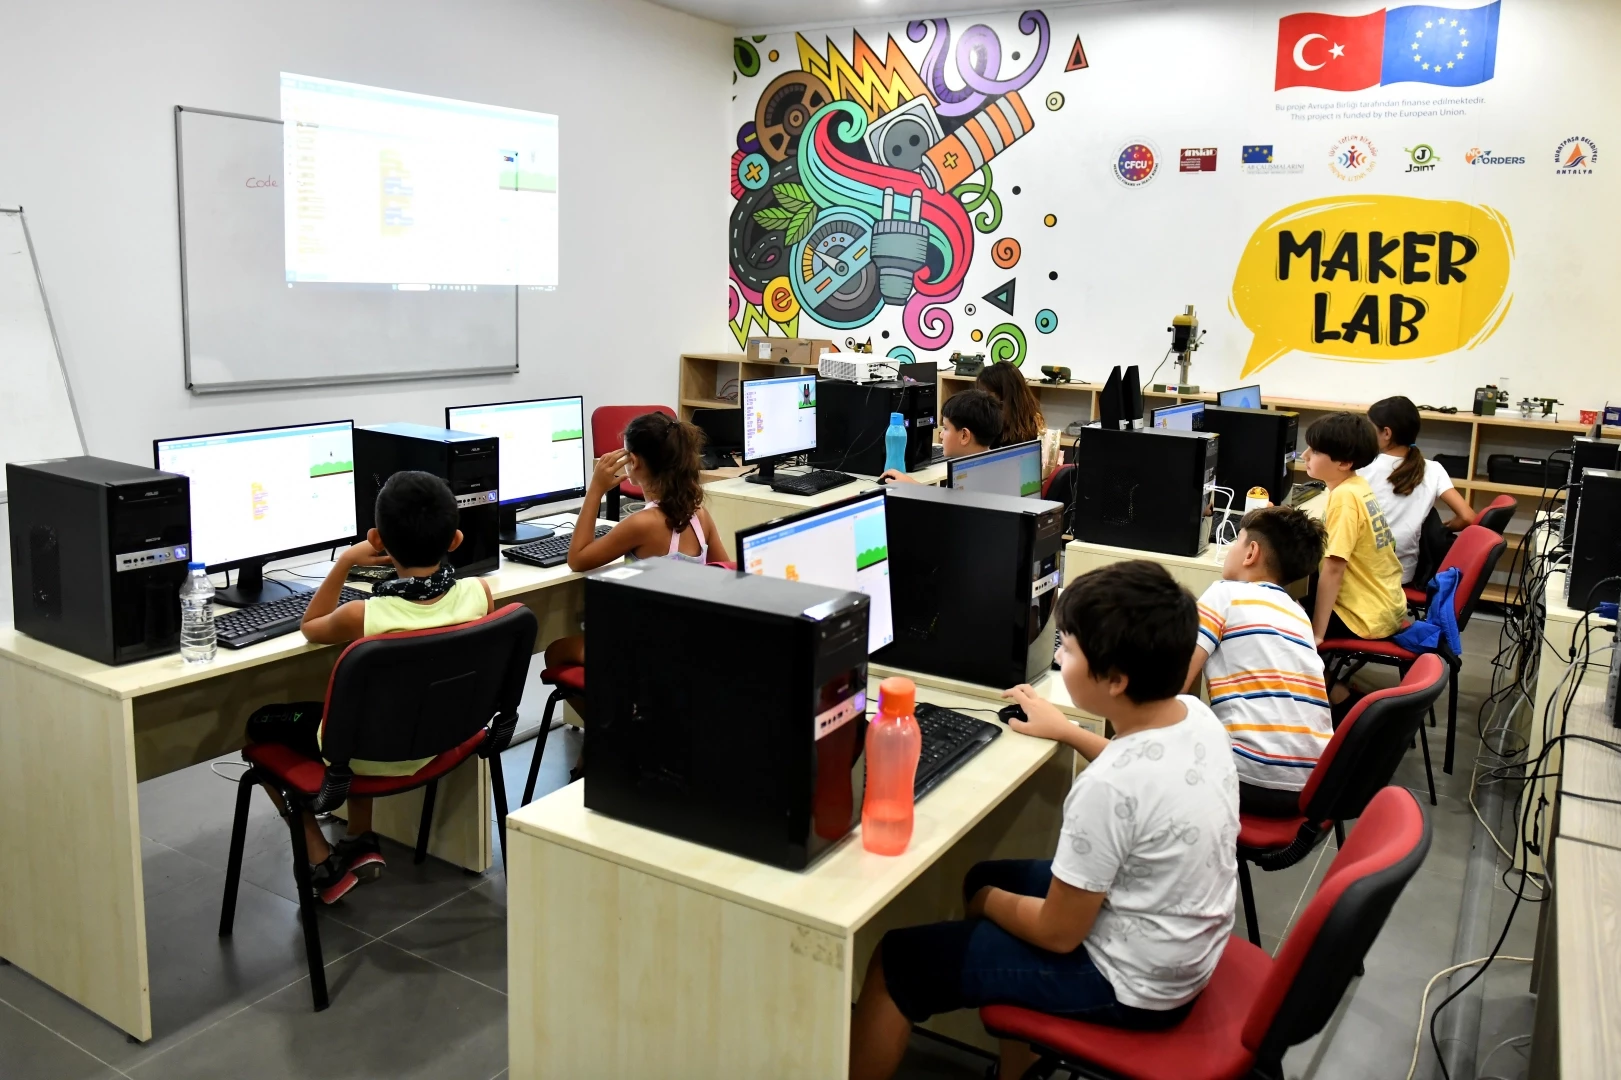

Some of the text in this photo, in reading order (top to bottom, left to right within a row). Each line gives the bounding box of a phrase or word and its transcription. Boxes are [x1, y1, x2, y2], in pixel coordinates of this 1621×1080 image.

[1275, 103, 1285, 111] Bu
[1286, 104, 1306, 112] proje
[1307, 102, 1335, 111] Avrupa
[1401, 98, 1431, 107] finanse
[1291, 113, 1306, 121] This
[1307, 112, 1334, 121] project
[1343, 111, 1371, 119] funded
[1373, 110, 1383, 119] by
[1384, 110, 1397, 118] the
[1399, 109, 1438, 118] European
[1439, 108, 1467, 116] Union.
[1416, 149, 1427, 160] J
[1124, 160, 1148, 169] CFCU
[245, 174, 279, 188] Code
[1276, 229, 1479, 286] MAKER
[1311, 291, 1429, 346] LAB
